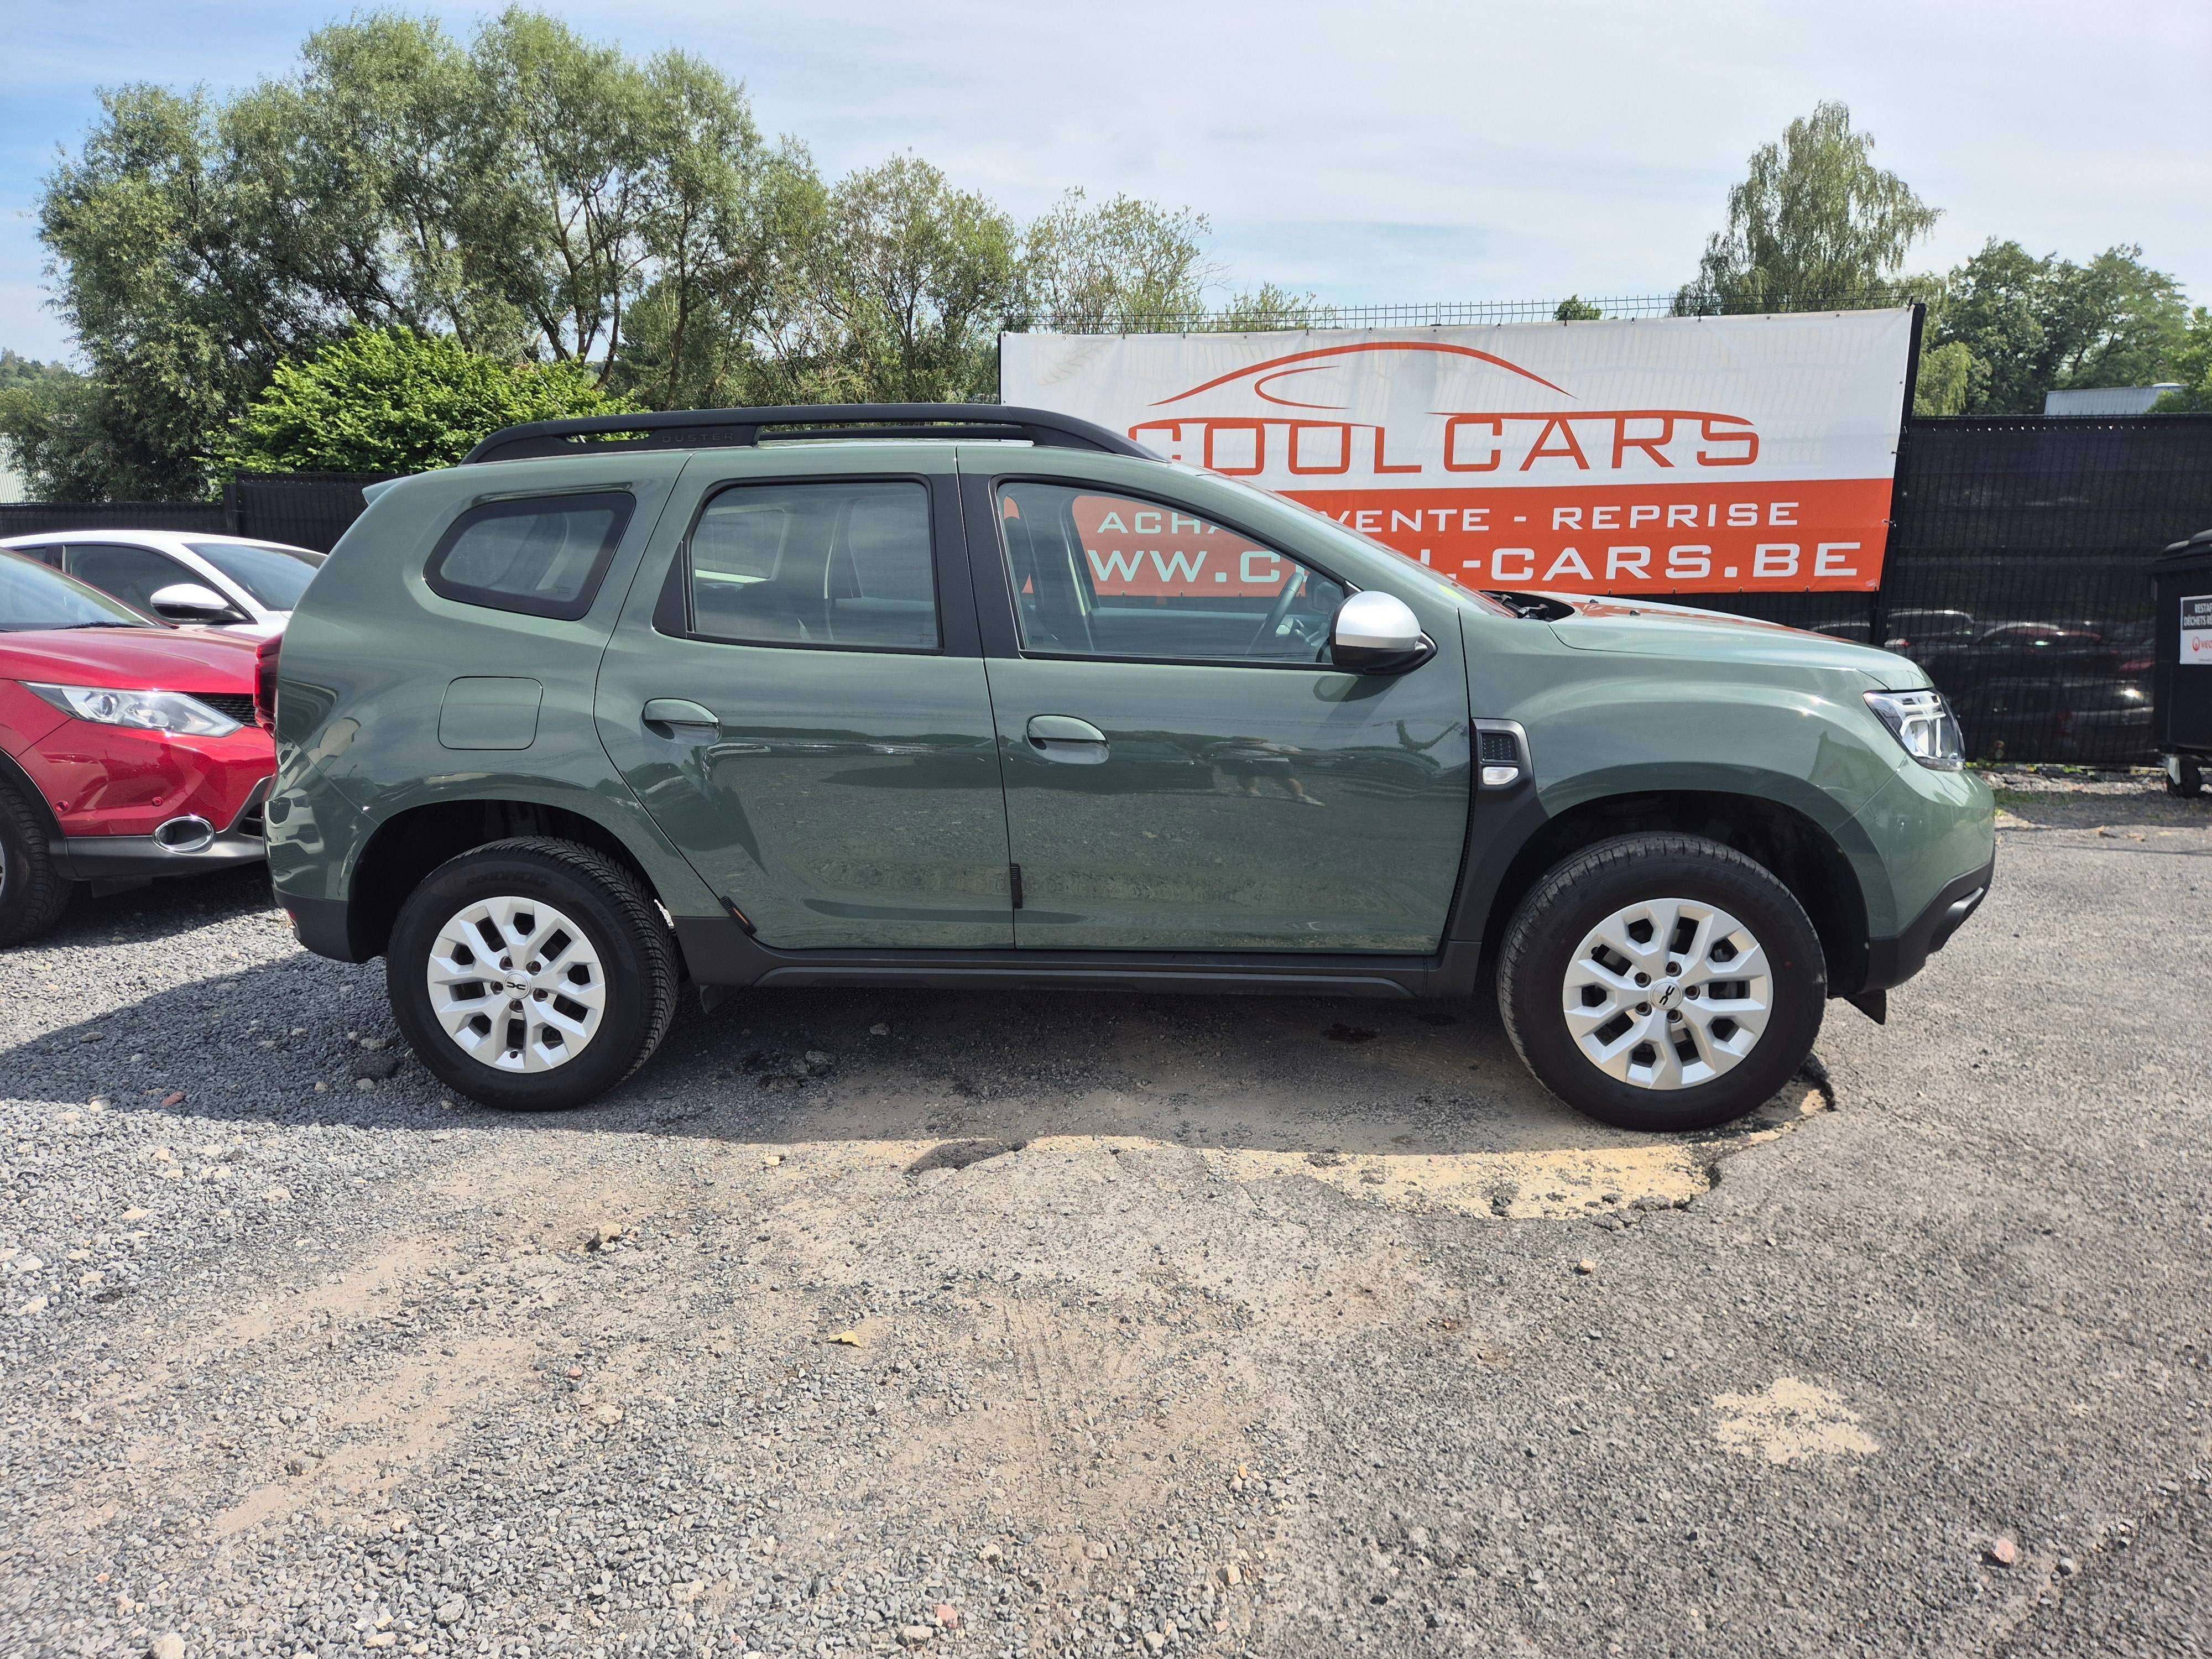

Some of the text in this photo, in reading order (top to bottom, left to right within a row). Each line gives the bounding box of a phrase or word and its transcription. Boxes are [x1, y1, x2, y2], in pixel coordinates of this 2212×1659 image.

[1425, 410, 1760, 472] CARS
[1097, 512, 1220, 534] ACH
[1552, 502, 1799, 531] REPRISE
